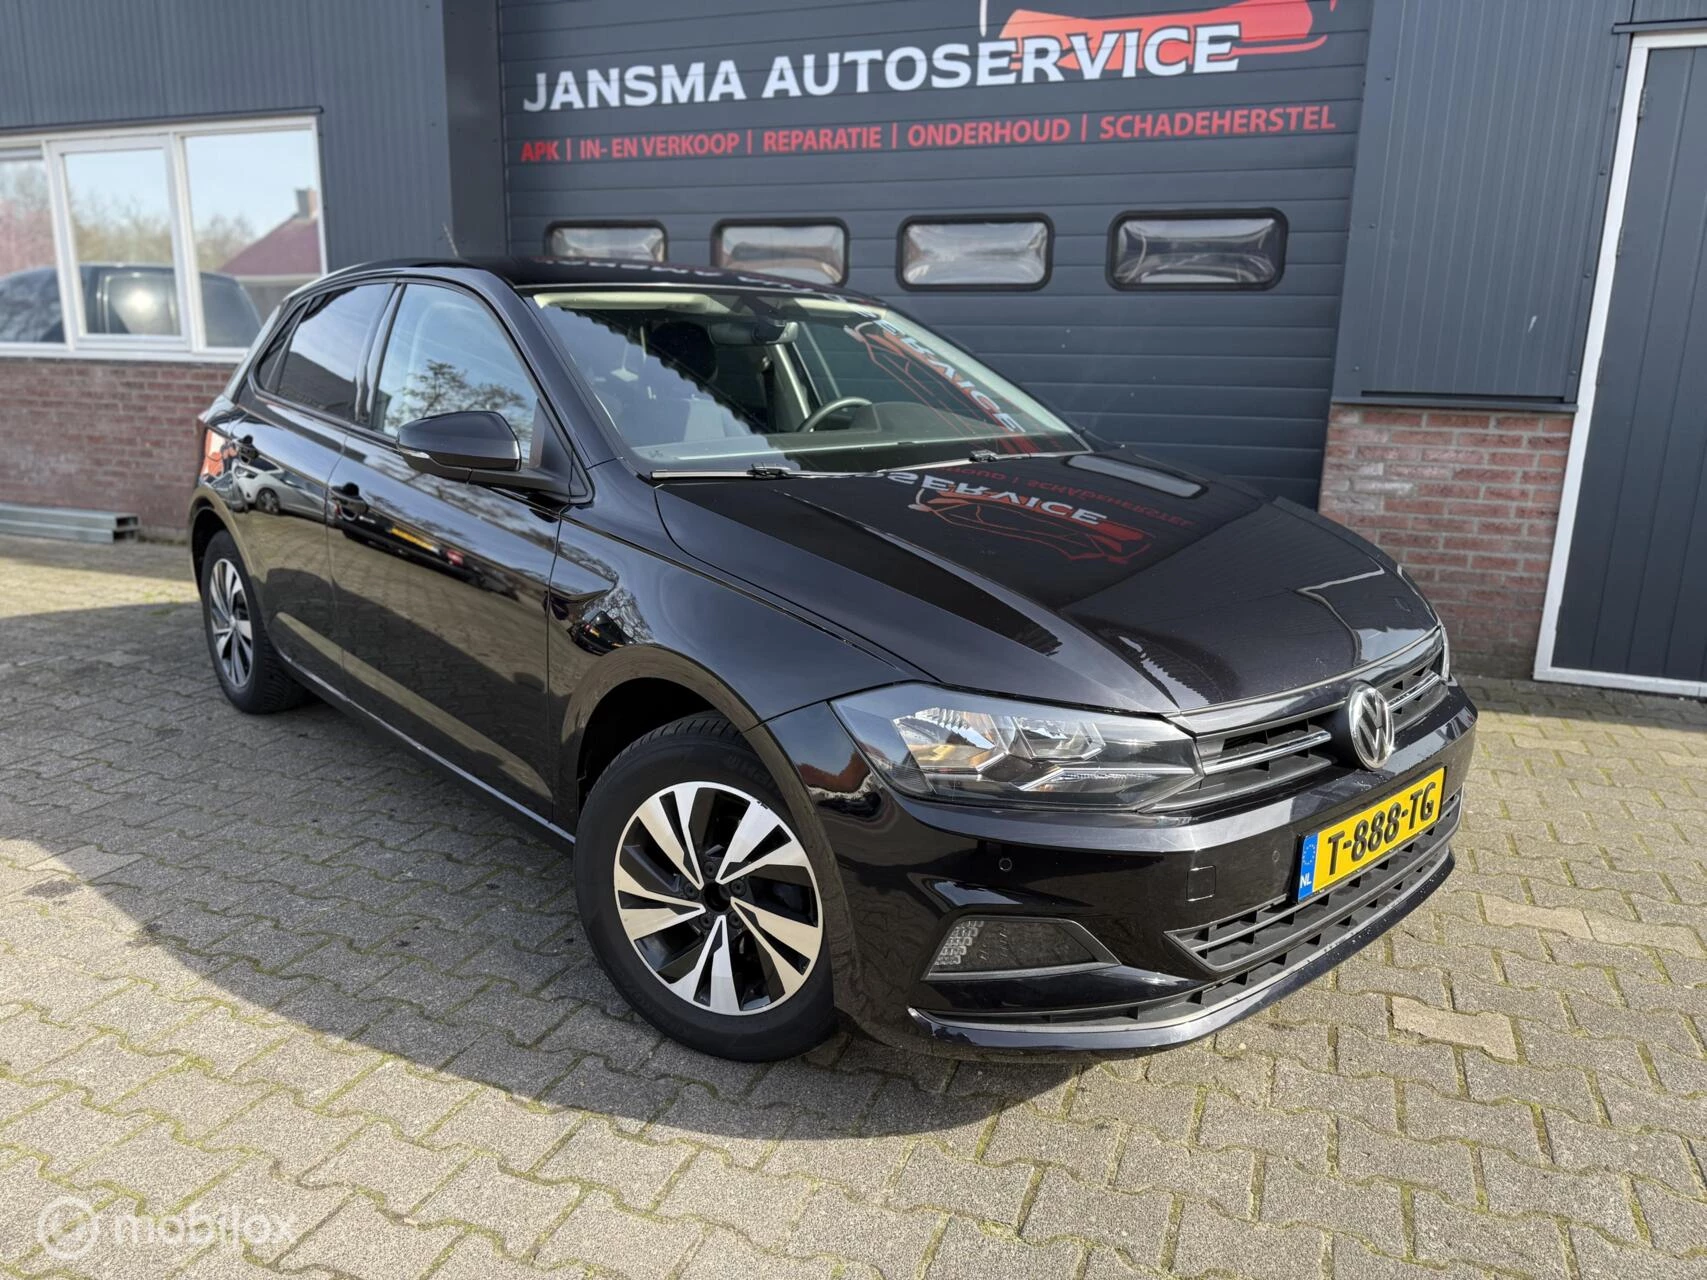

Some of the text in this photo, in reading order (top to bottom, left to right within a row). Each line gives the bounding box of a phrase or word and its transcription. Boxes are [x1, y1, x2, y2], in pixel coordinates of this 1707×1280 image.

[522, 22, 1241, 113] JANSMA AUTOSERVICE
[520, 105, 1337, 163] APK IN- EN VERKOOP REPARATIE ONDERHOUD SCHADEHERSTEL
[1327, 780, 1437, 876] T-888-TG
[1300, 873, 1312, 889] NL
